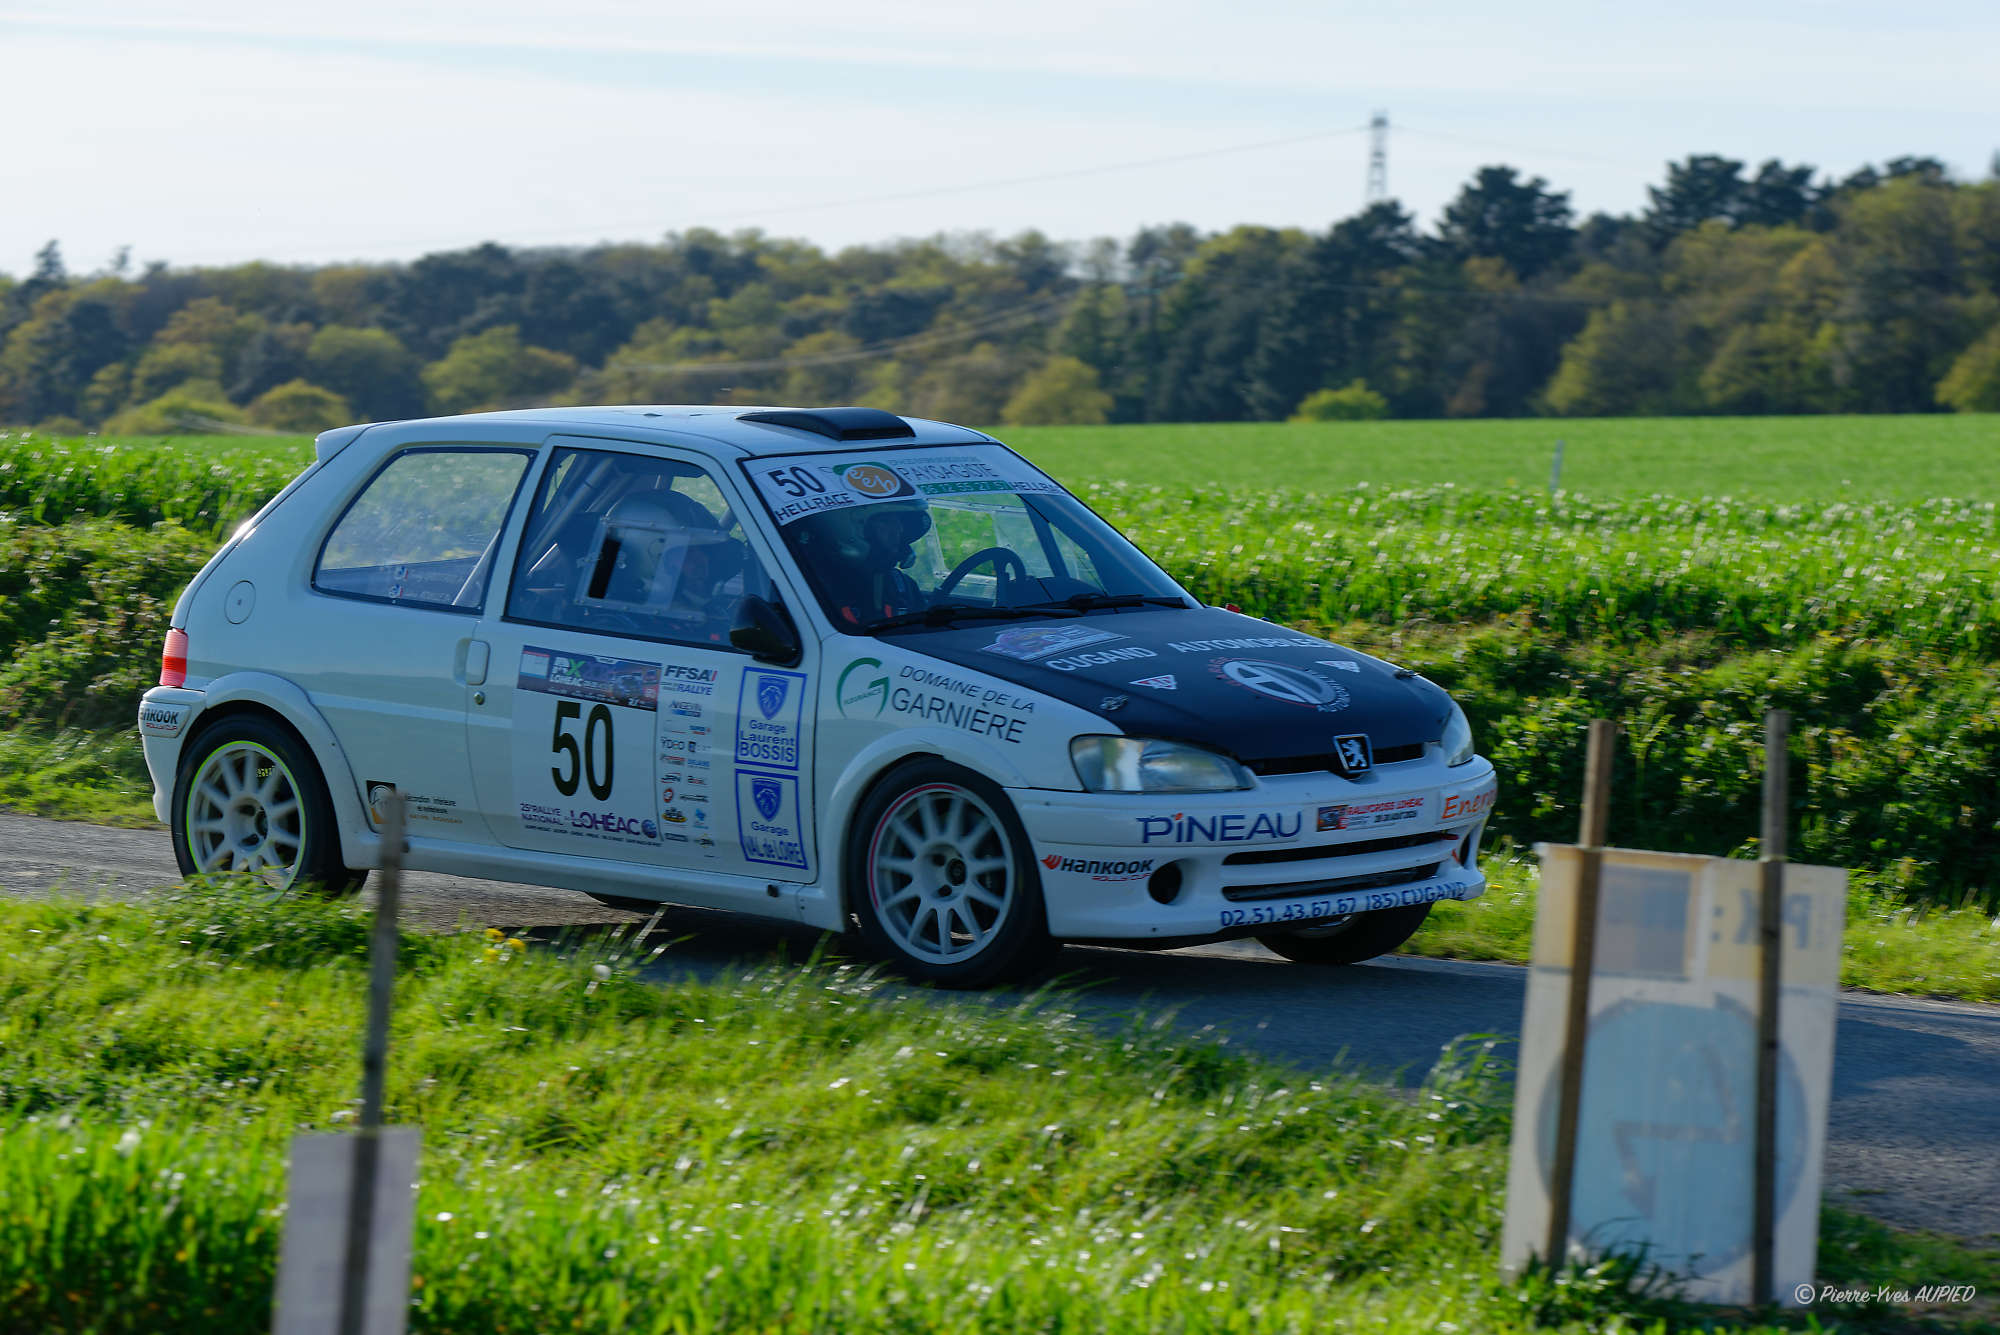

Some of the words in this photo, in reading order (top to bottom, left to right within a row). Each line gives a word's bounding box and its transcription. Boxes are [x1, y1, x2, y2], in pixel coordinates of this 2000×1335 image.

[768, 466, 826, 498] 50
[774, 492, 856, 522] HELLRACE
[1044, 646, 1159, 672] CUGAND
[900, 665, 982, 698] DOMAINE
[982, 690, 1011, 706] DE
[1011, 699, 1036, 714] LA
[749, 719, 787, 734] Garage
[892, 687, 1027, 744] GARNIÈRE
[552, 700, 614, 802] 50
[739, 730, 795, 747] Laurent
[739, 741, 795, 763] BOSSIS
[570, 810, 641, 836] LOHÉAC
[751, 821, 789, 836] Garage
